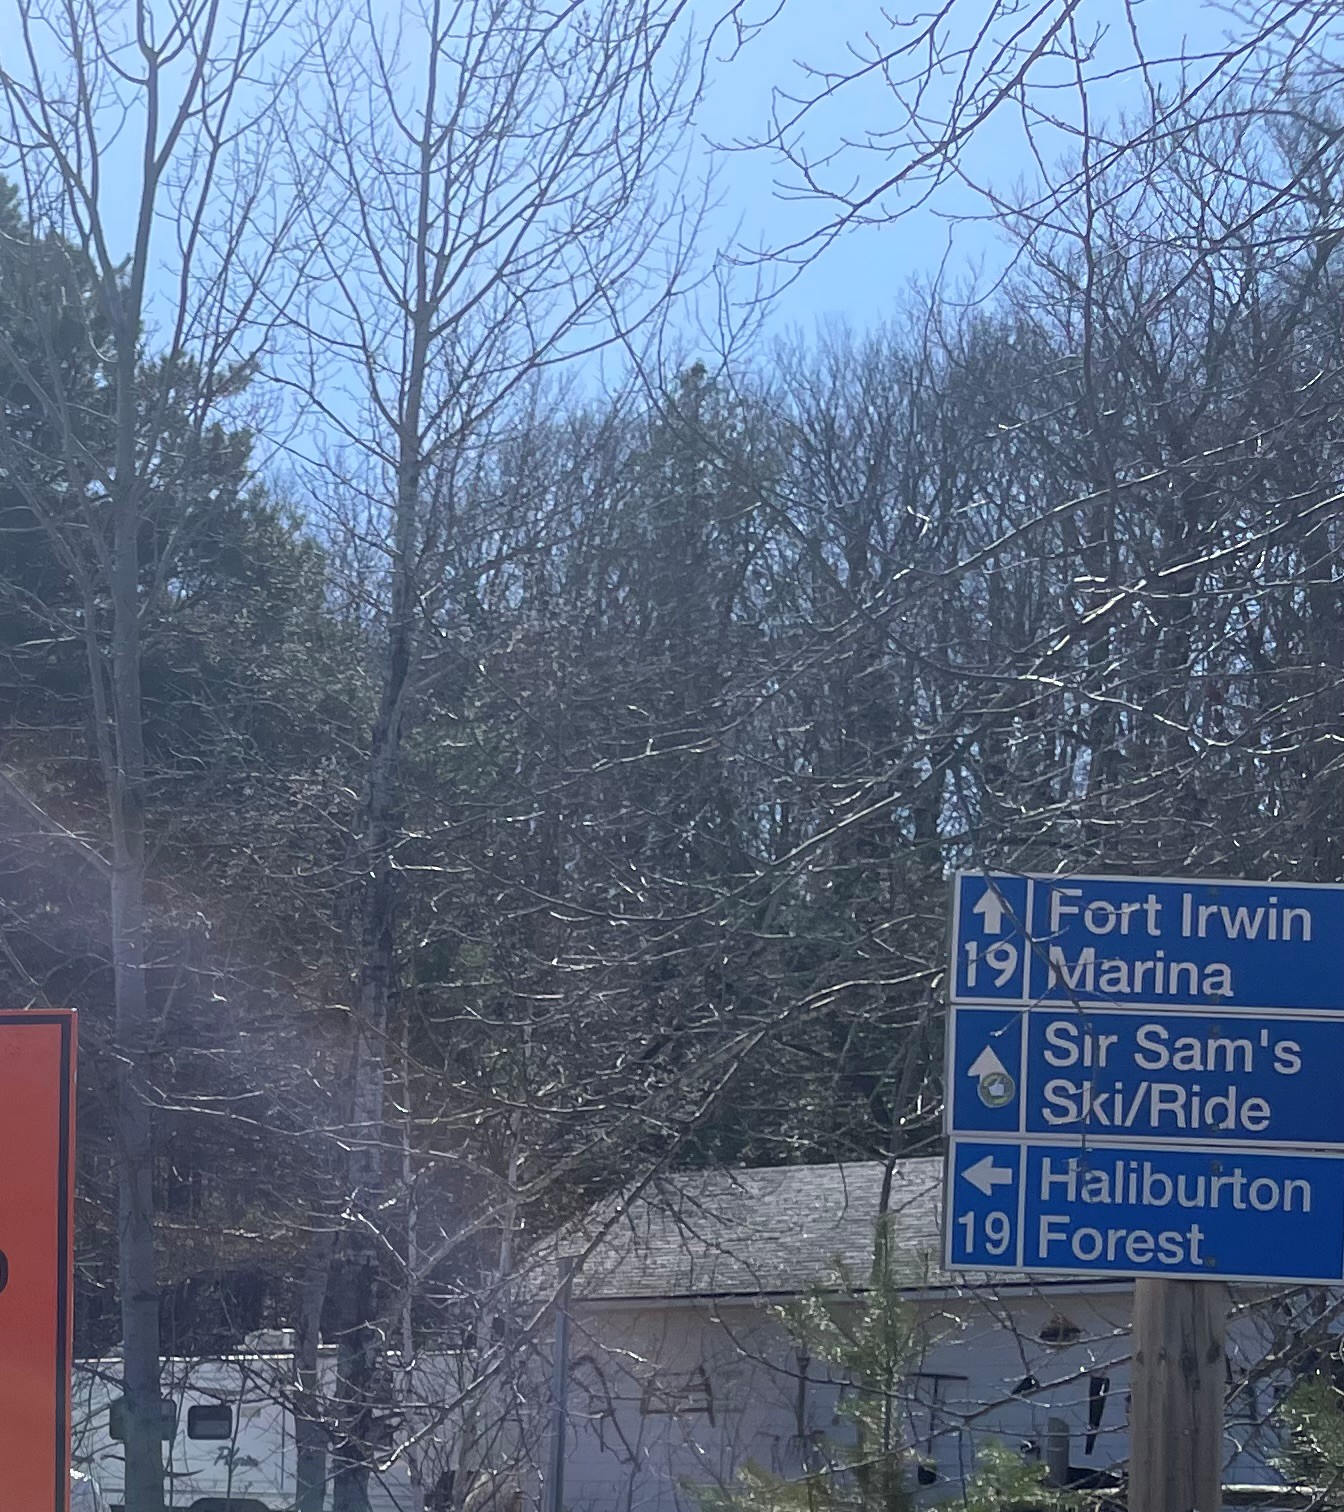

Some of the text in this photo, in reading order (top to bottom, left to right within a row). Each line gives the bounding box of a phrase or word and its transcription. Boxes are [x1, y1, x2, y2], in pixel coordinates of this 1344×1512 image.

[1050, 888, 1312, 942] Fort Irwin
[964, 941, 1019, 988] 19
[1048, 946, 1234, 997] Marina
[1043, 1020, 1302, 1075] Sir Sam's
[1041, 1079, 1272, 1132] Ski/Ride
[1040, 1156, 1312, 1213] Haliburton
[958, 1210, 1011, 1256] 19
[1038, 1214, 1205, 1266] Forest
